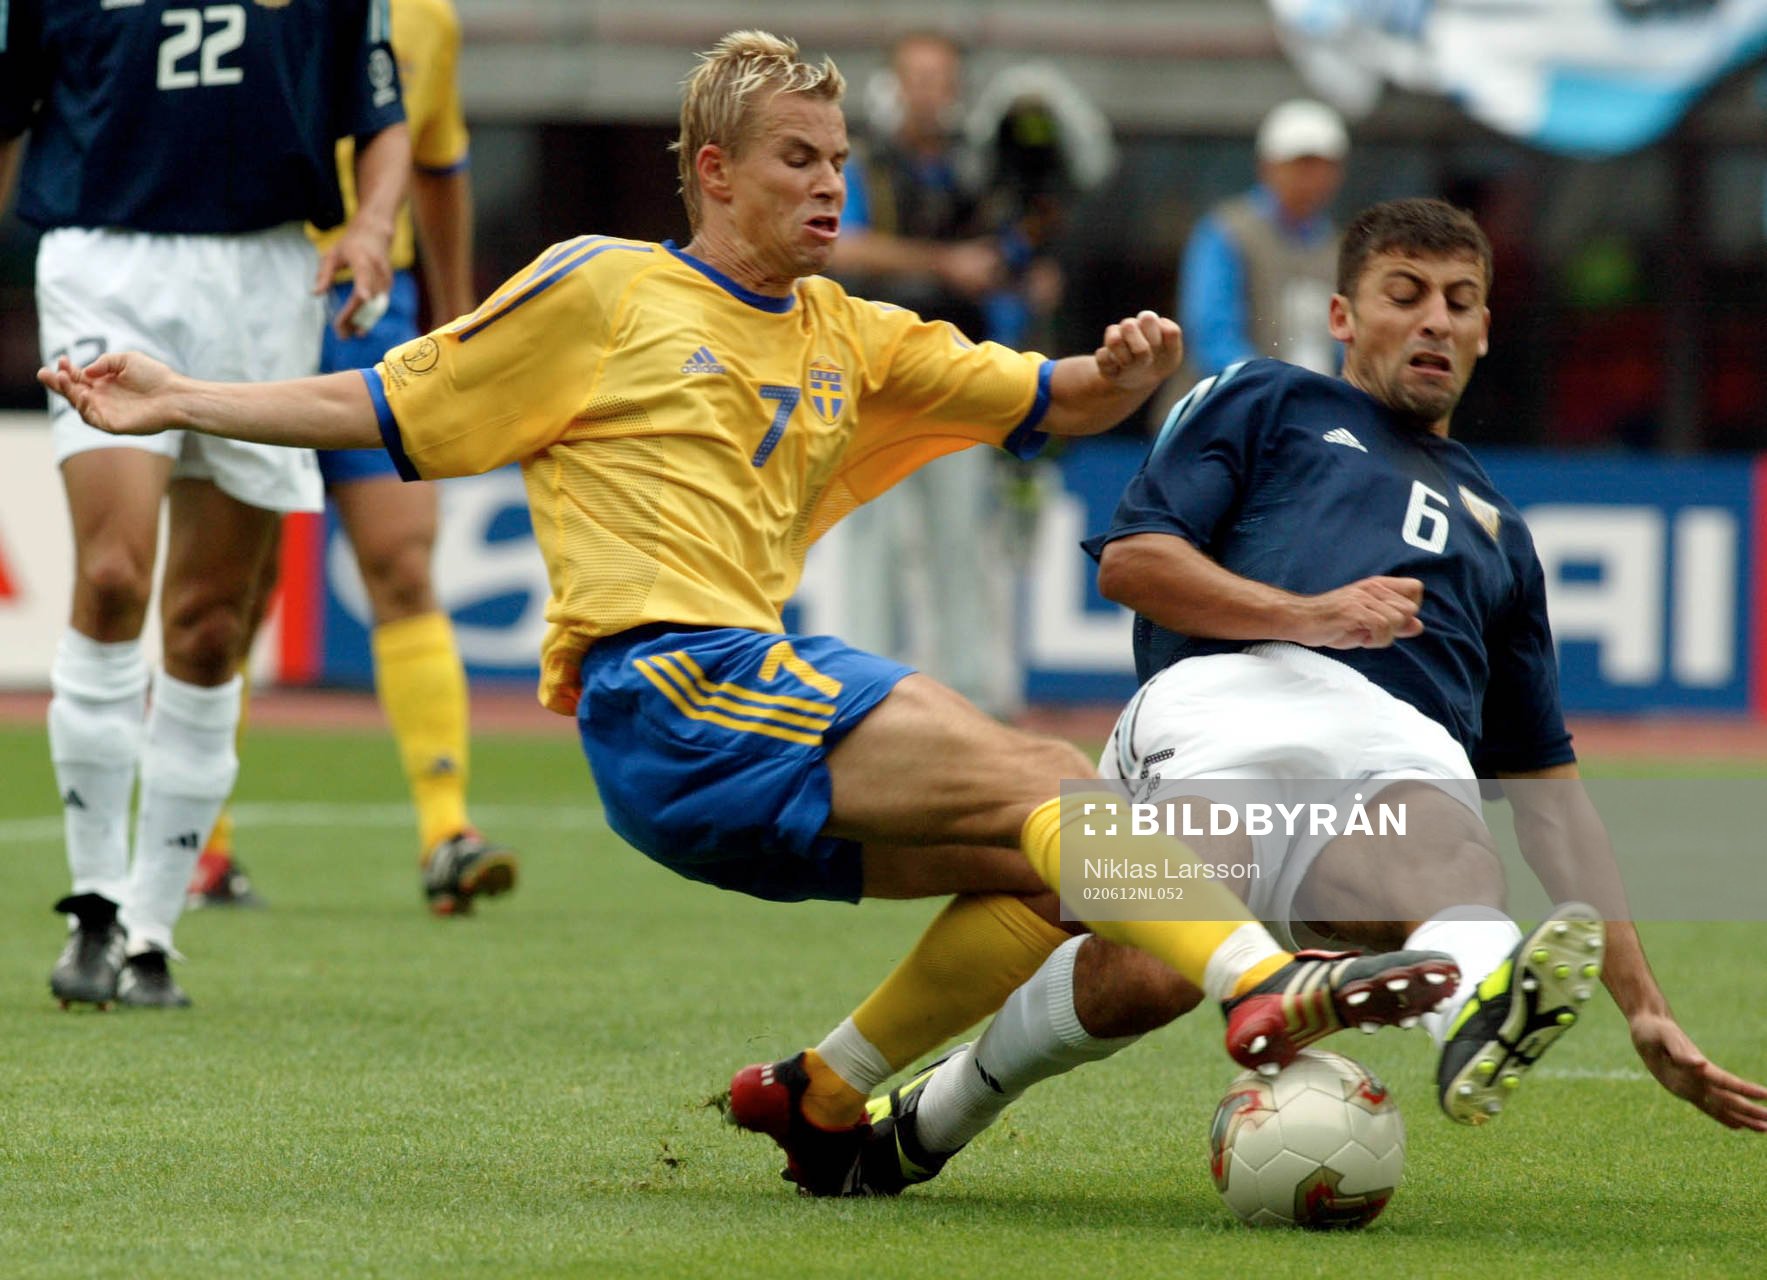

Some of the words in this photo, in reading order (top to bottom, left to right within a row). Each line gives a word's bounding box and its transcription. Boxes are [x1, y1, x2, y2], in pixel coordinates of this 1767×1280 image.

[157, 4, 246, 90] 22
[752, 384, 800, 467] 7
[1402, 480, 1449, 554] 6
[757, 641, 842, 698] 7
